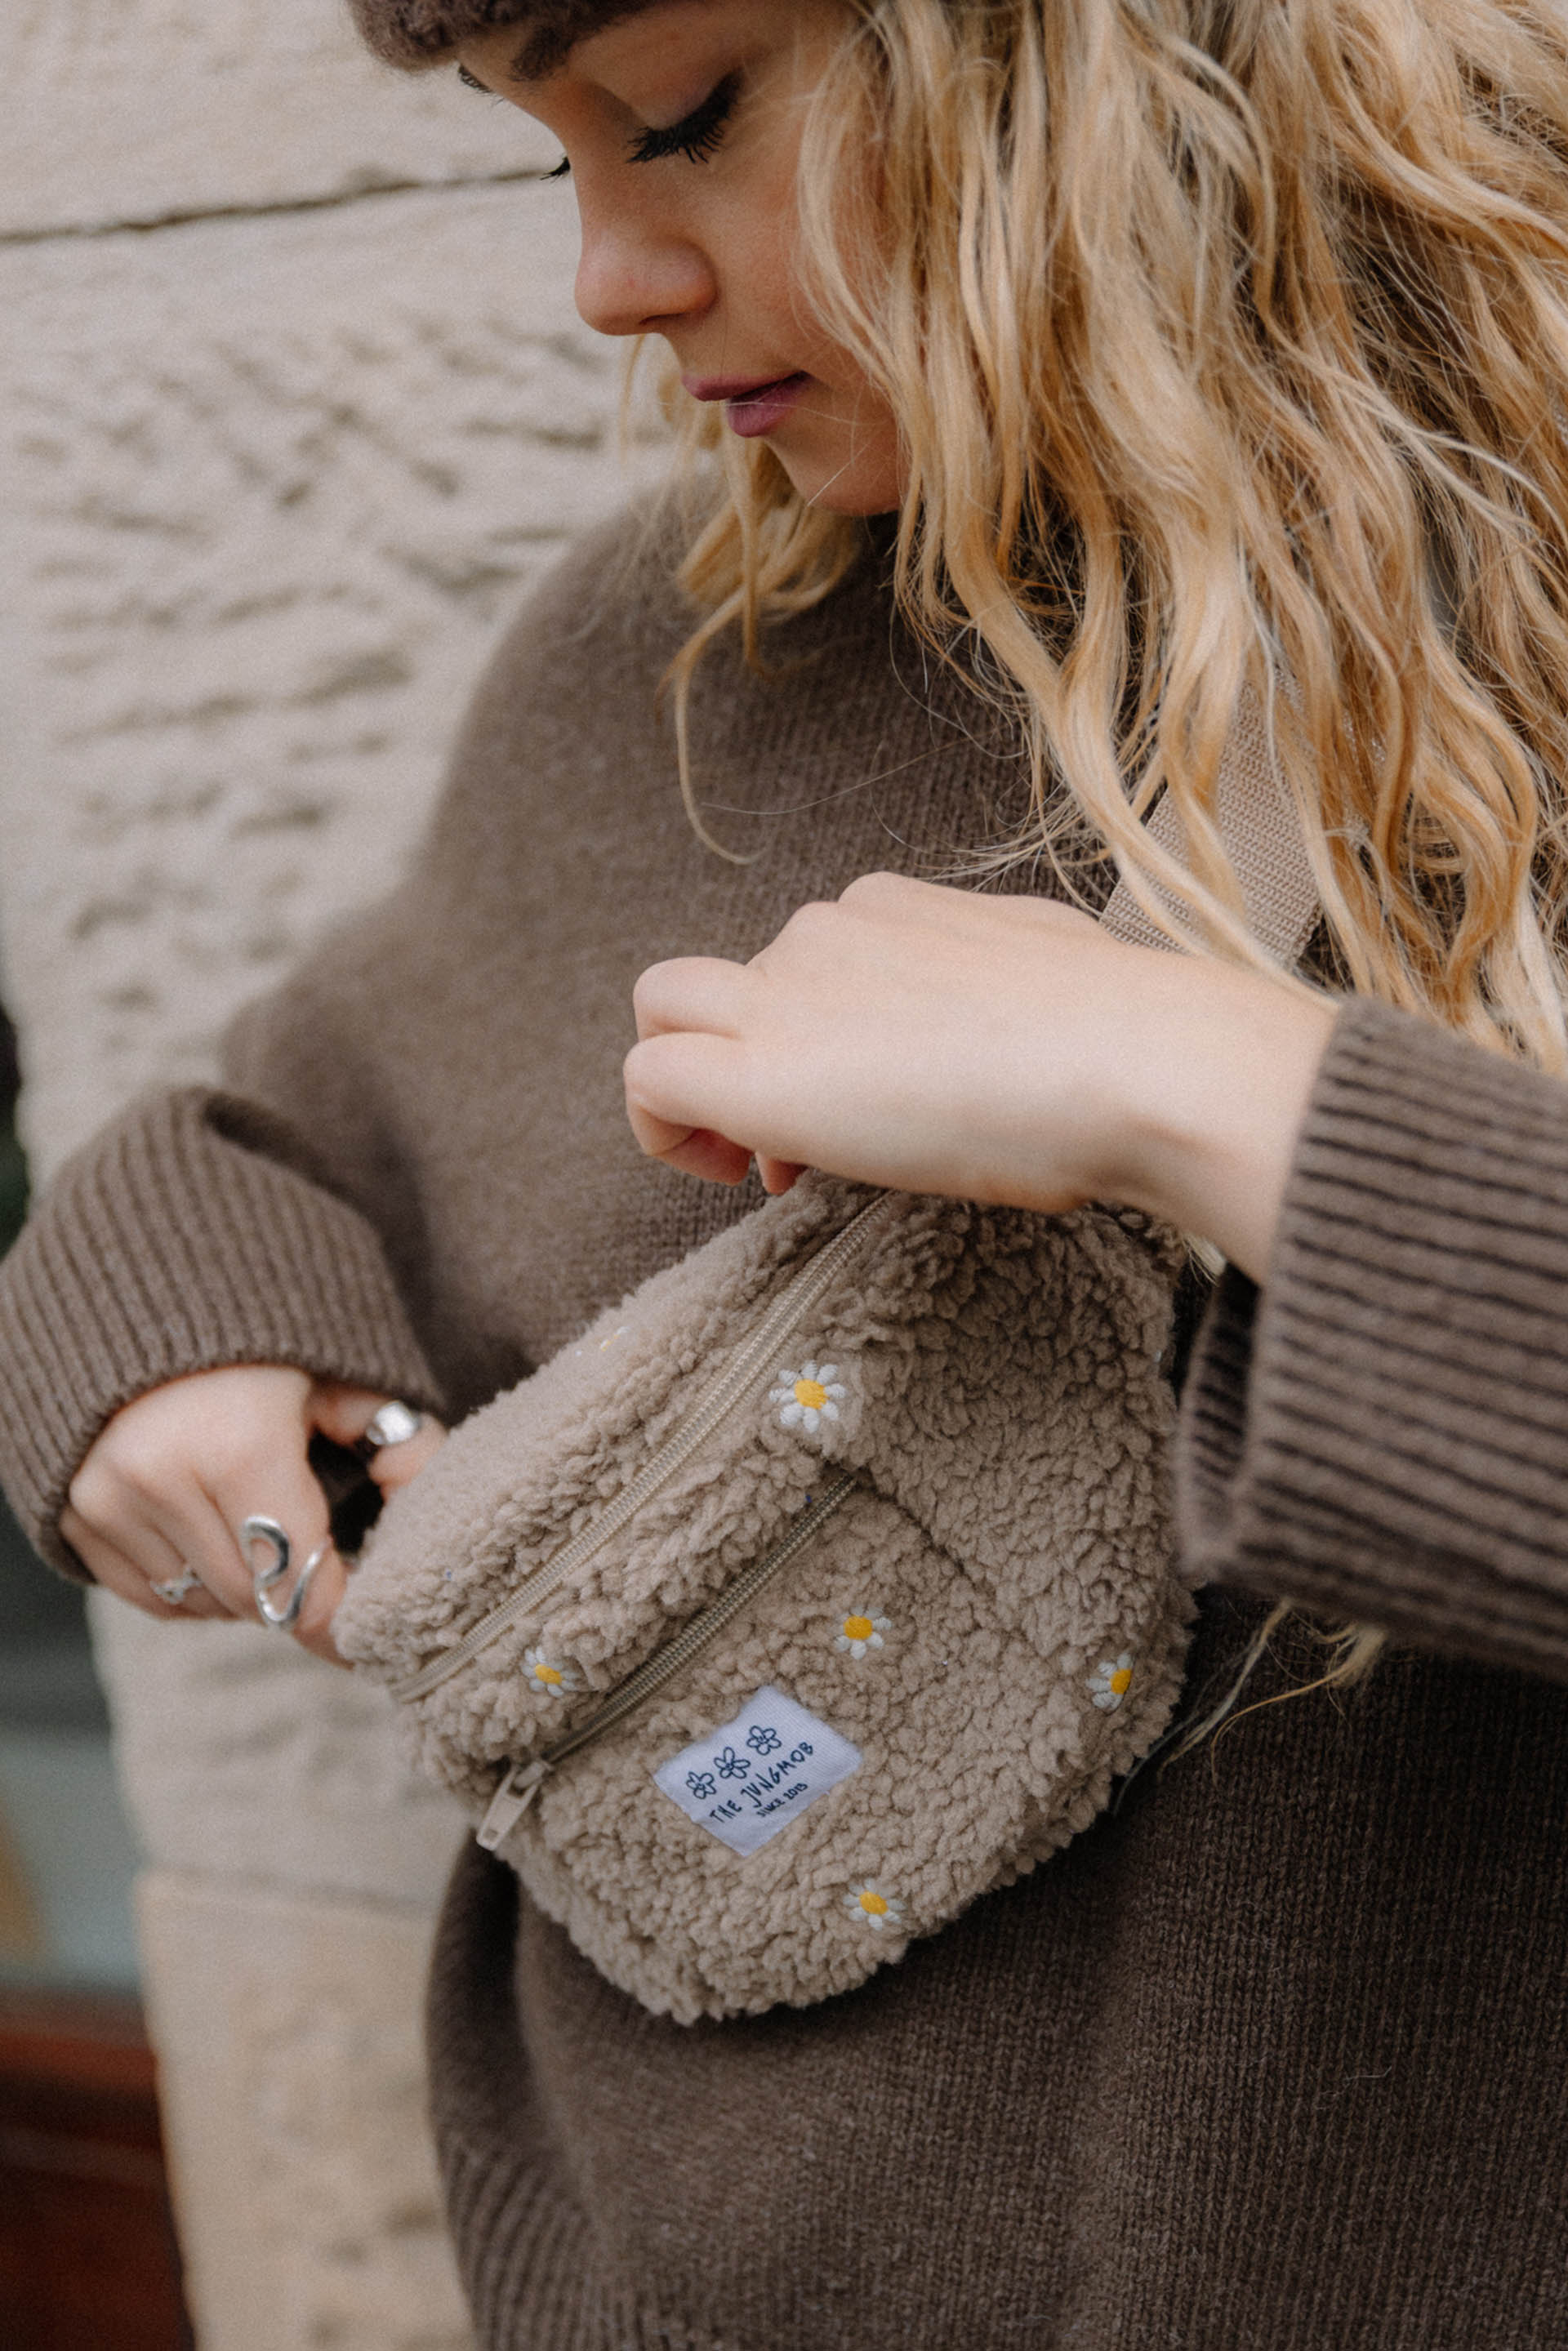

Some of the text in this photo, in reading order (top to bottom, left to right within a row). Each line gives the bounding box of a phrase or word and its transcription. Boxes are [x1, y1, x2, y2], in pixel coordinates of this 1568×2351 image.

[709, 1742, 813, 1823] THE JUNGMOB
[756, 1798, 786, 1817] SINCE
